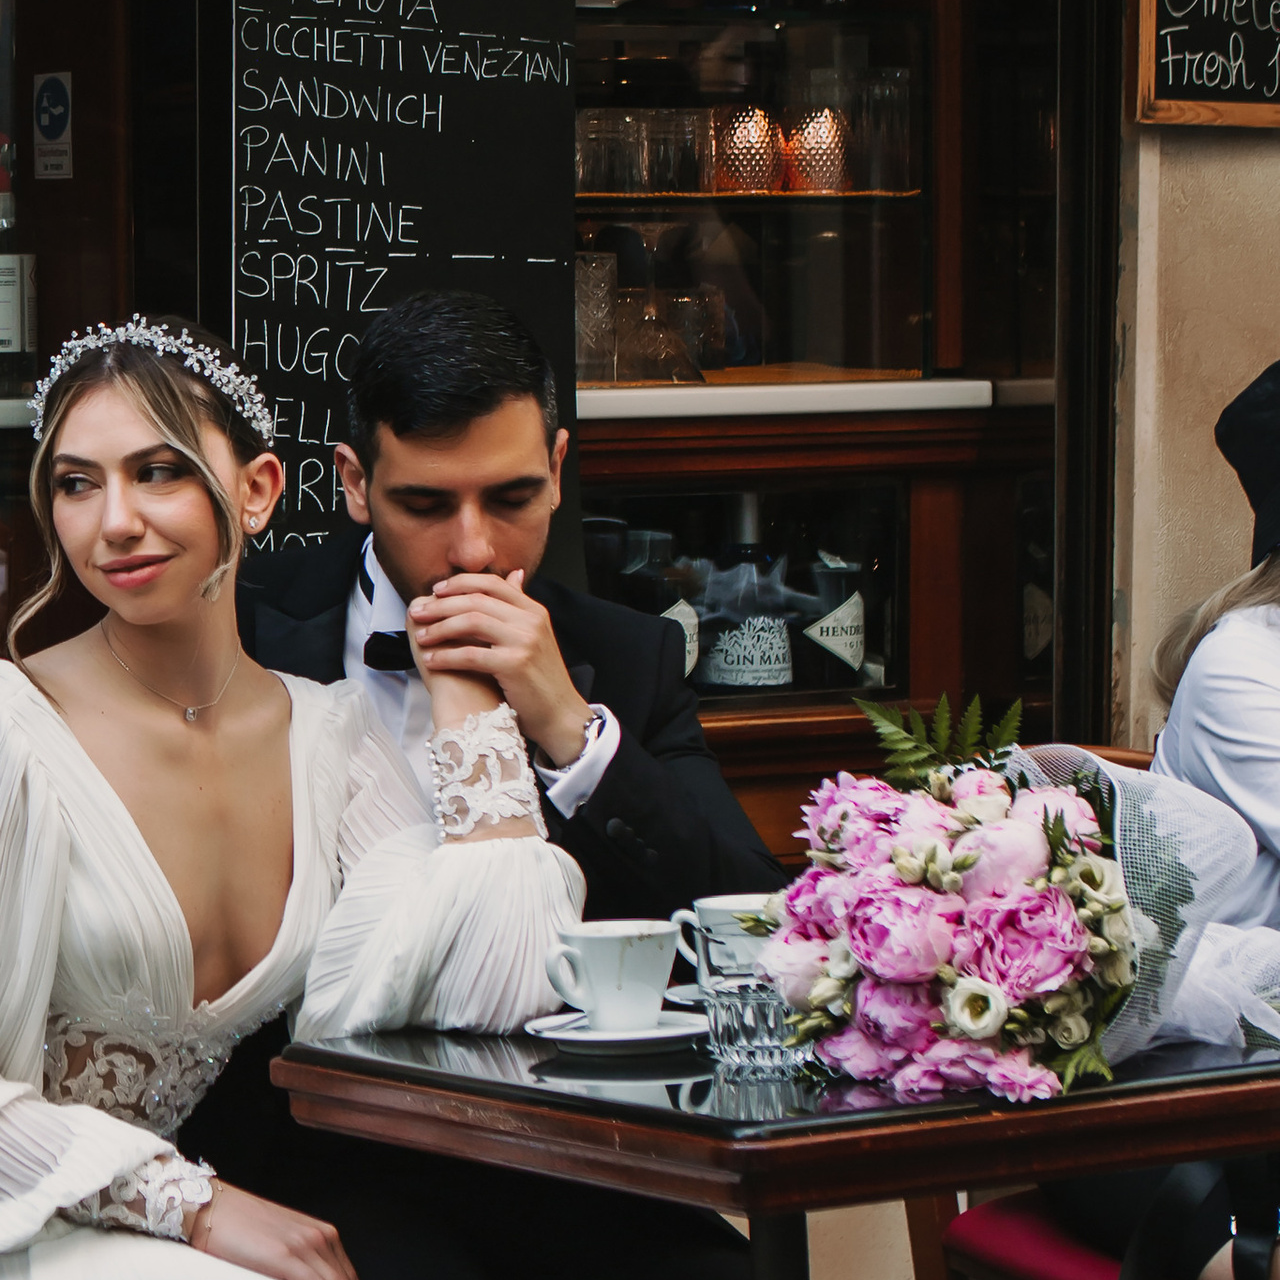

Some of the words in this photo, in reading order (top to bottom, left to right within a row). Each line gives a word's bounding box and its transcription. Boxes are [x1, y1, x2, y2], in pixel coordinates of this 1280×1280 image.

[241, 16, 404, 72] CICCHETTI
[422, 40, 570, 87] VENEZIANI
[1160, 25, 1255, 91] Fresh
[238, 68, 444, 133] SANDWICH
[239, 125, 387, 187] PANINI
[239, 185, 423, 244] PASTINE
[237, 250, 389, 313] SPRITZ
[724, 654, 754, 666] GIN
